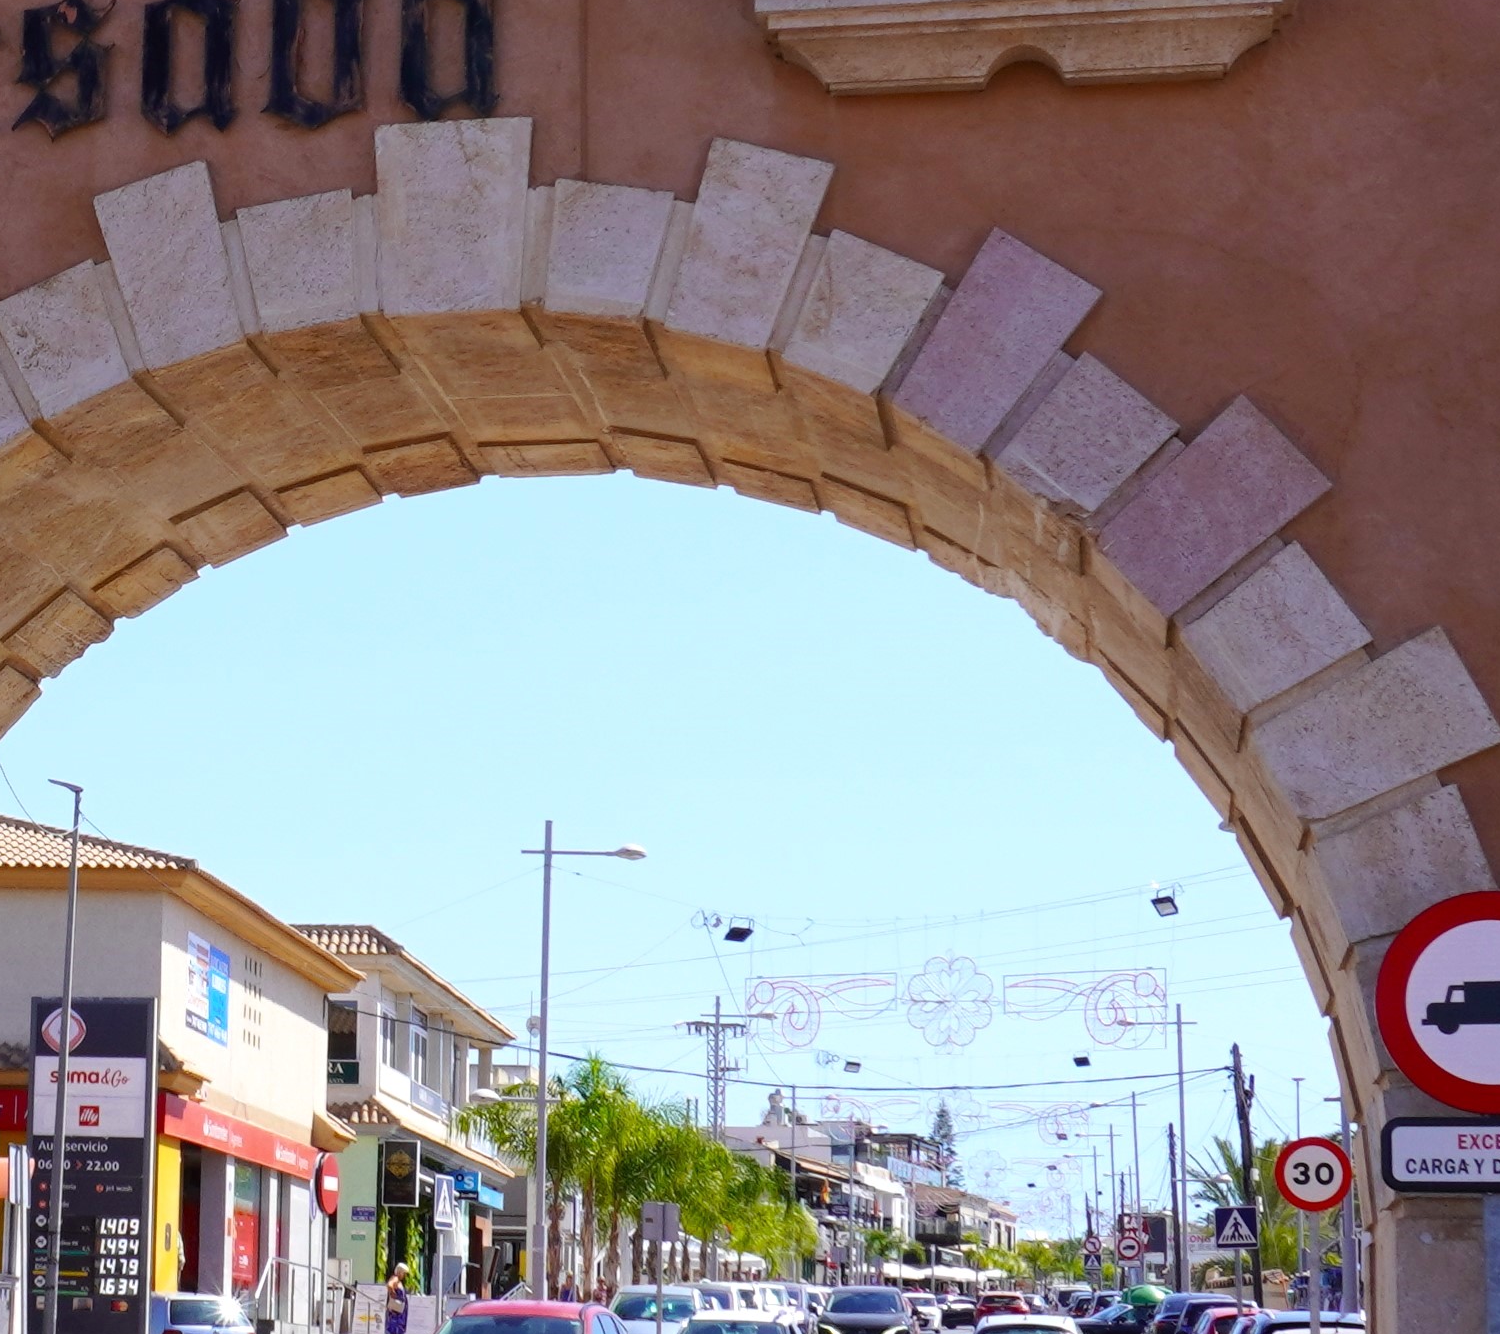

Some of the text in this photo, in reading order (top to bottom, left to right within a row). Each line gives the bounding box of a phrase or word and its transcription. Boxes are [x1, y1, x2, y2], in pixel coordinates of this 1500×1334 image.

[79, 1108, 99, 1125] illy
[38, 1139, 109, 1154] Auservicio
[86, 1159, 120, 1172] 22.00
[1292, 1162, 1335, 1186] 30
[1405, 1158, 1470, 1175] CARGA
[1474, 1158, 1485, 1175] Y
